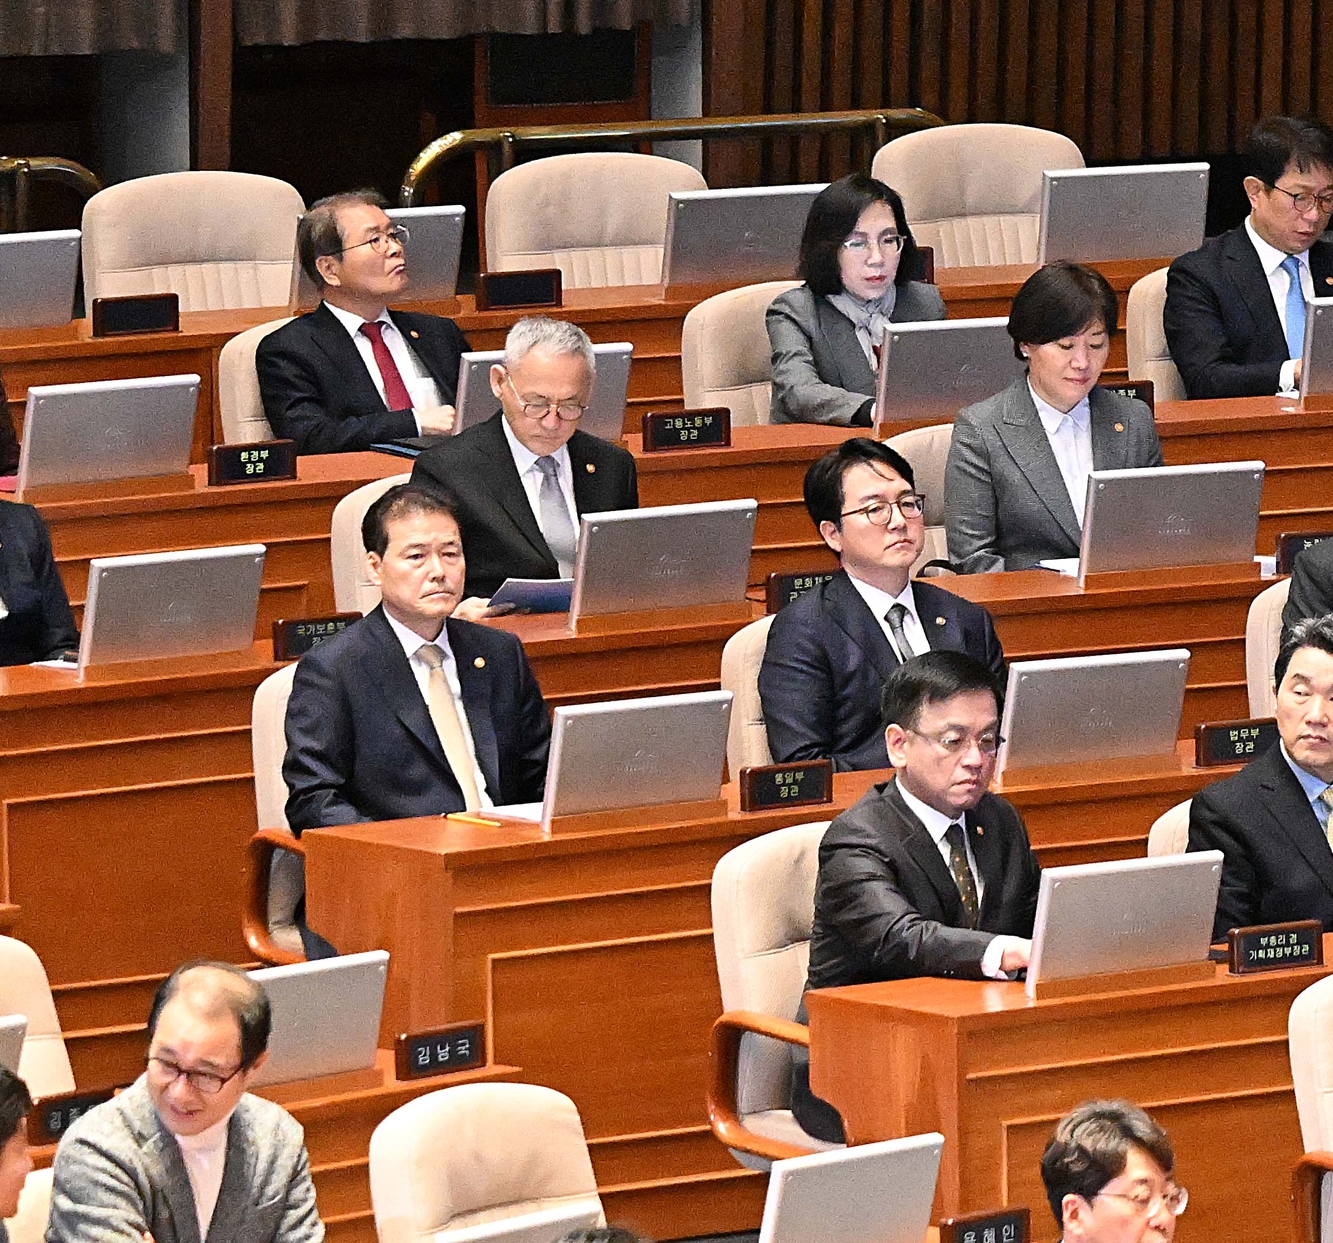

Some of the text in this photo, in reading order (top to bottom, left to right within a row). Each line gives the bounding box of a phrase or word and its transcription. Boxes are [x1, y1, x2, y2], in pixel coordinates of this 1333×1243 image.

[664, 416, 713, 429] 고용노동부
[680, 429, 698, 441] 장관
[240, 449, 270, 463] 환경부
[245, 462, 265, 475] 장관
[1229, 727, 1260, 741] 법무부
[1235, 741, 1255, 754] 장관
[774, 771, 804, 785] 통일부
[779, 785, 799, 798] 장관
[1260, 934, 1286, 947] 부총리
[1249, 944, 1310, 961] 기획재정부장관
[416, 1038, 471, 1066] 김남국
